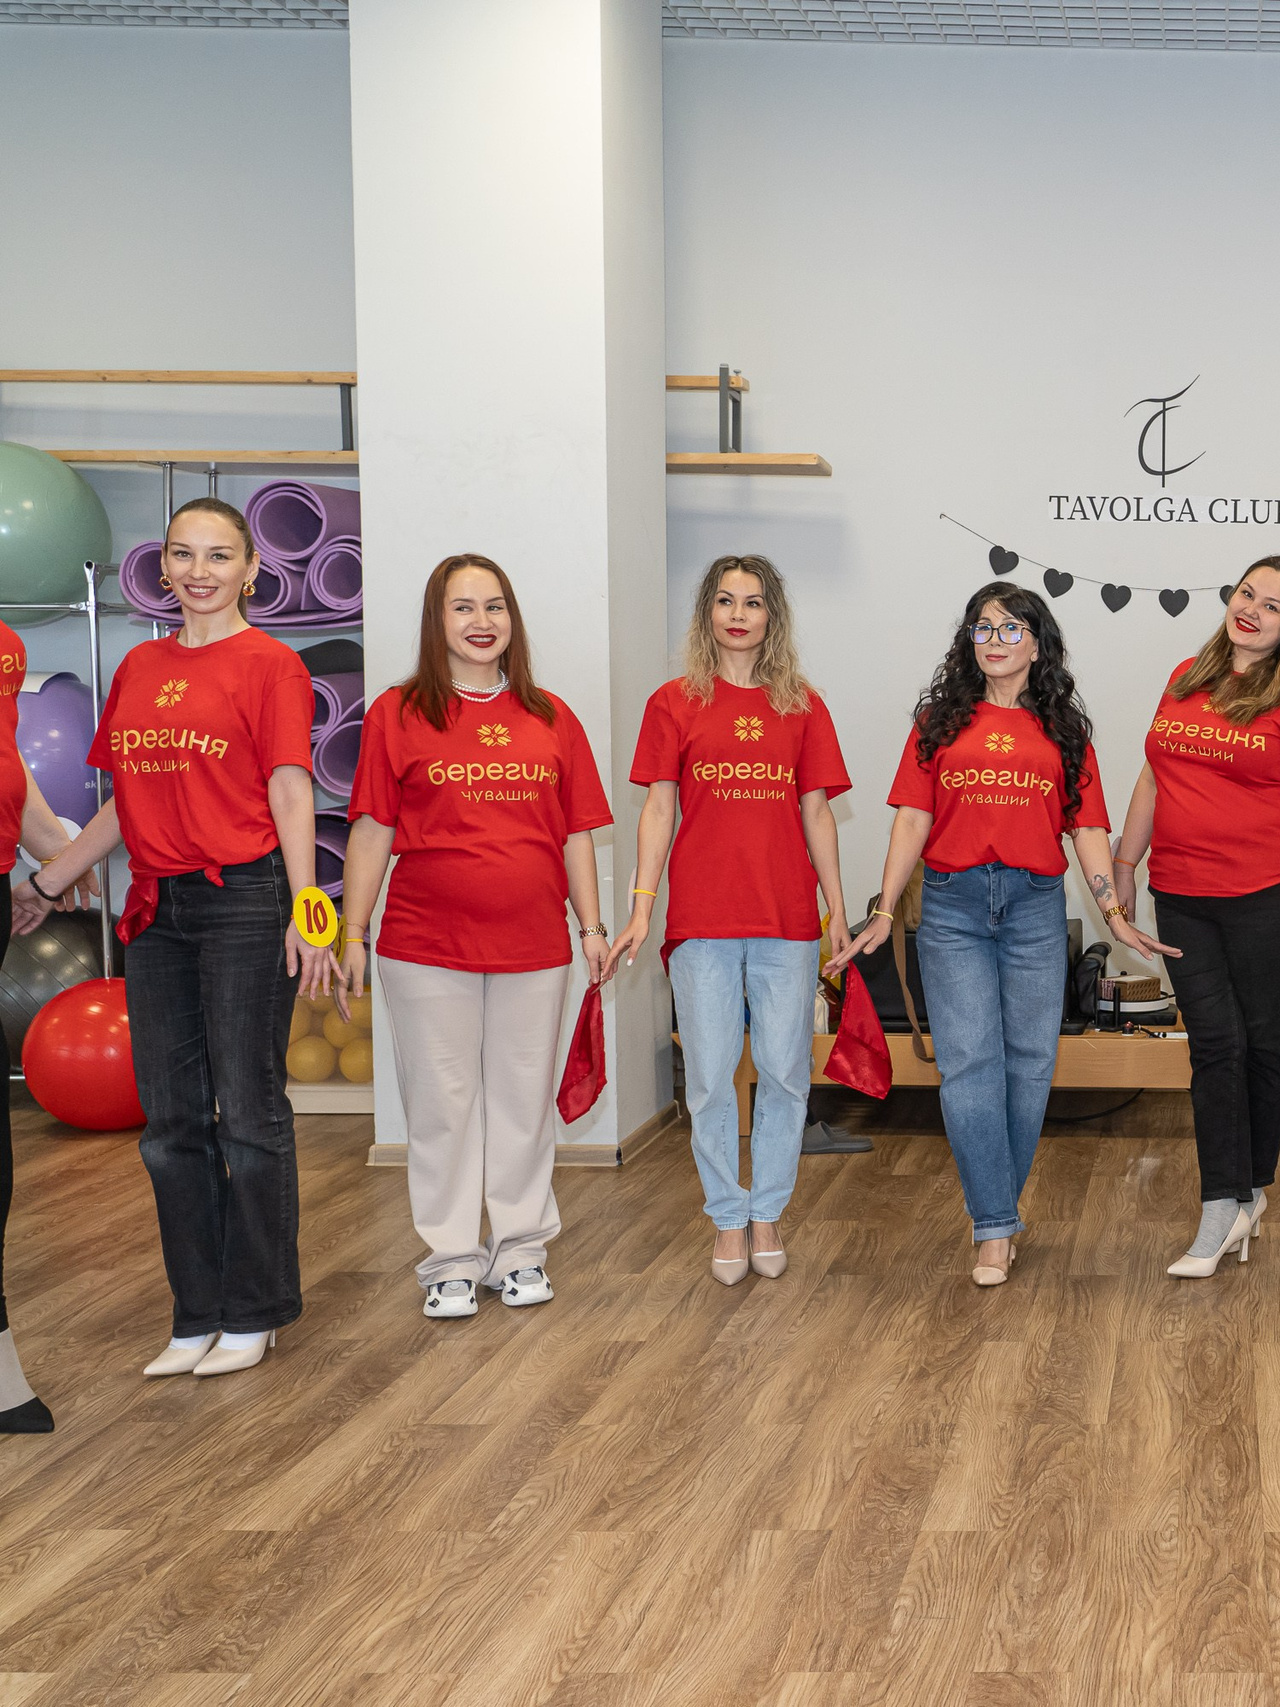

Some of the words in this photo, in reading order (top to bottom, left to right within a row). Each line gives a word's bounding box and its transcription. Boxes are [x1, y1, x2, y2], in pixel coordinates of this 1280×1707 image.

[1049, 495, 1198, 523] TAVOLGA
[110, 728, 229, 760] ерегиня
[692, 760, 796, 785] берегин
[712, 788, 786, 801] чувашии
[303, 898, 328, 934] 10
